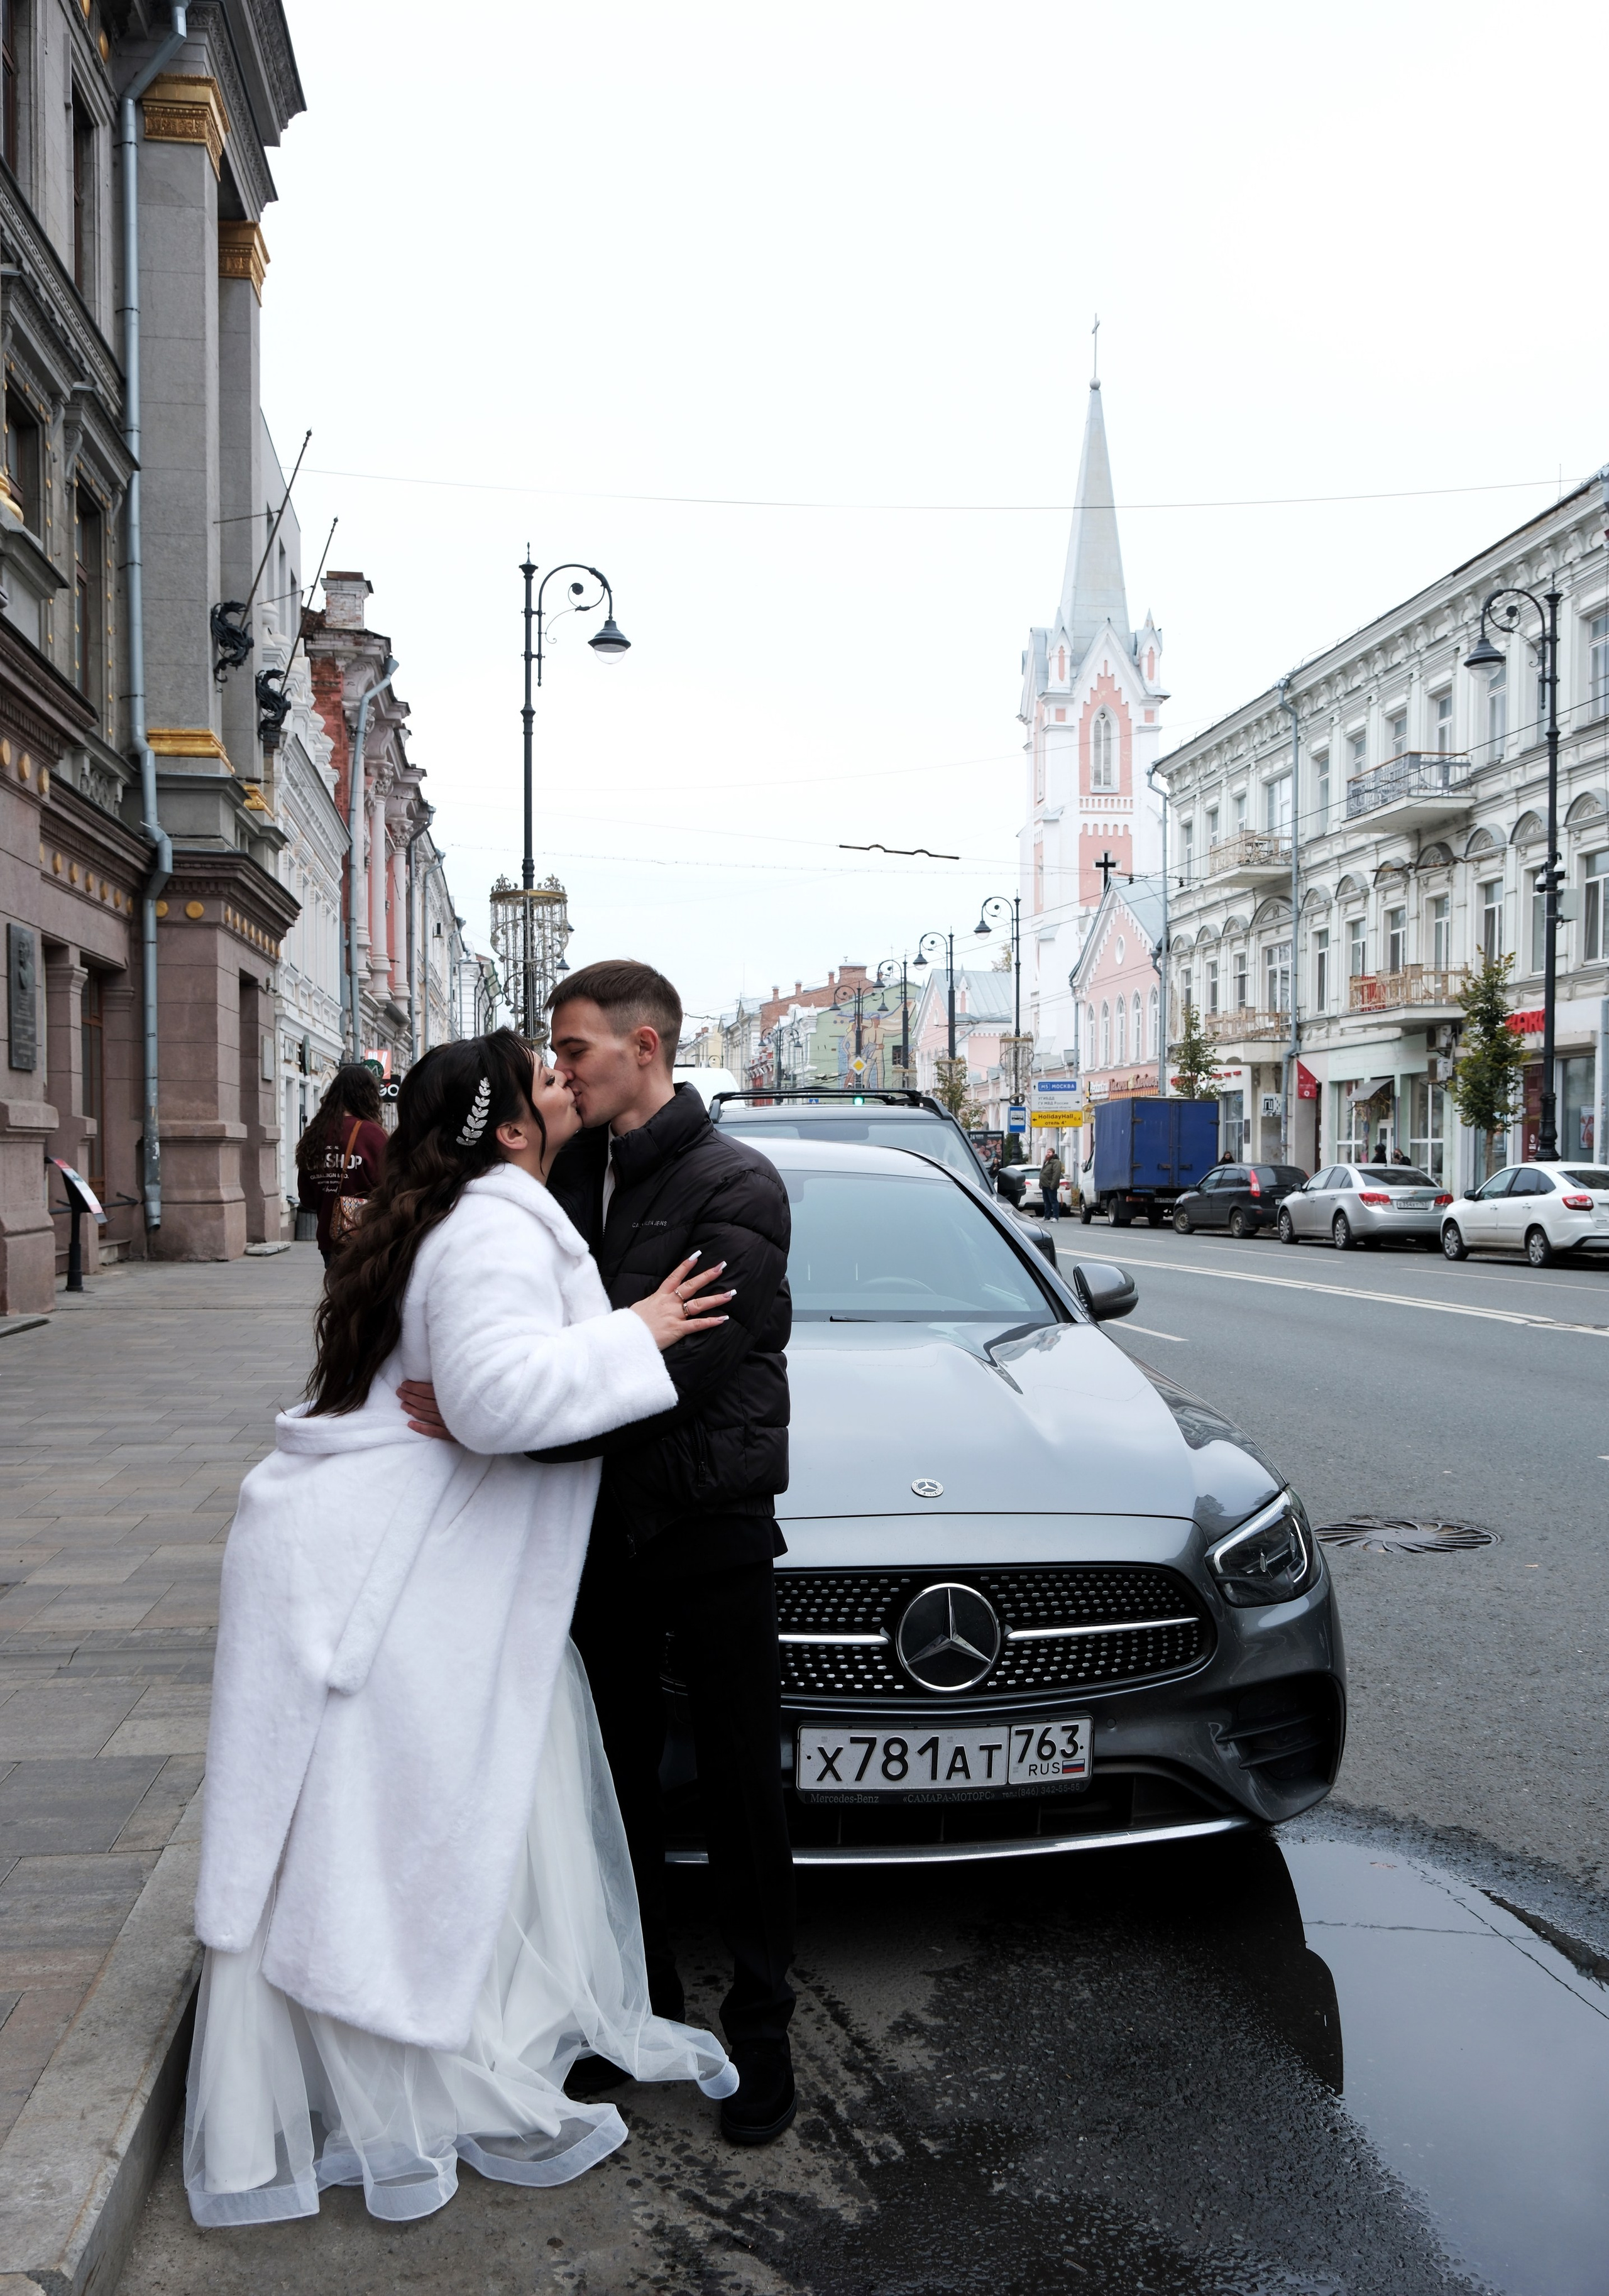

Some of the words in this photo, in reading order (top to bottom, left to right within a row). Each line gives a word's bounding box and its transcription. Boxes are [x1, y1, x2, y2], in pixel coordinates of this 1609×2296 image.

[816, 1736, 1002, 1781] Х781АТ
[1014, 1724, 1080, 1763] 763
[1029, 1762, 1061, 1776] RUS
[903, 1791, 995, 1803] «САМАРА-МОТОРС»
[1018, 1787, 1038, 1798] (846)
[1041, 1783, 1080, 1795] 342-55-55
[810, 1793, 879, 1803] Mercedes-Benz
